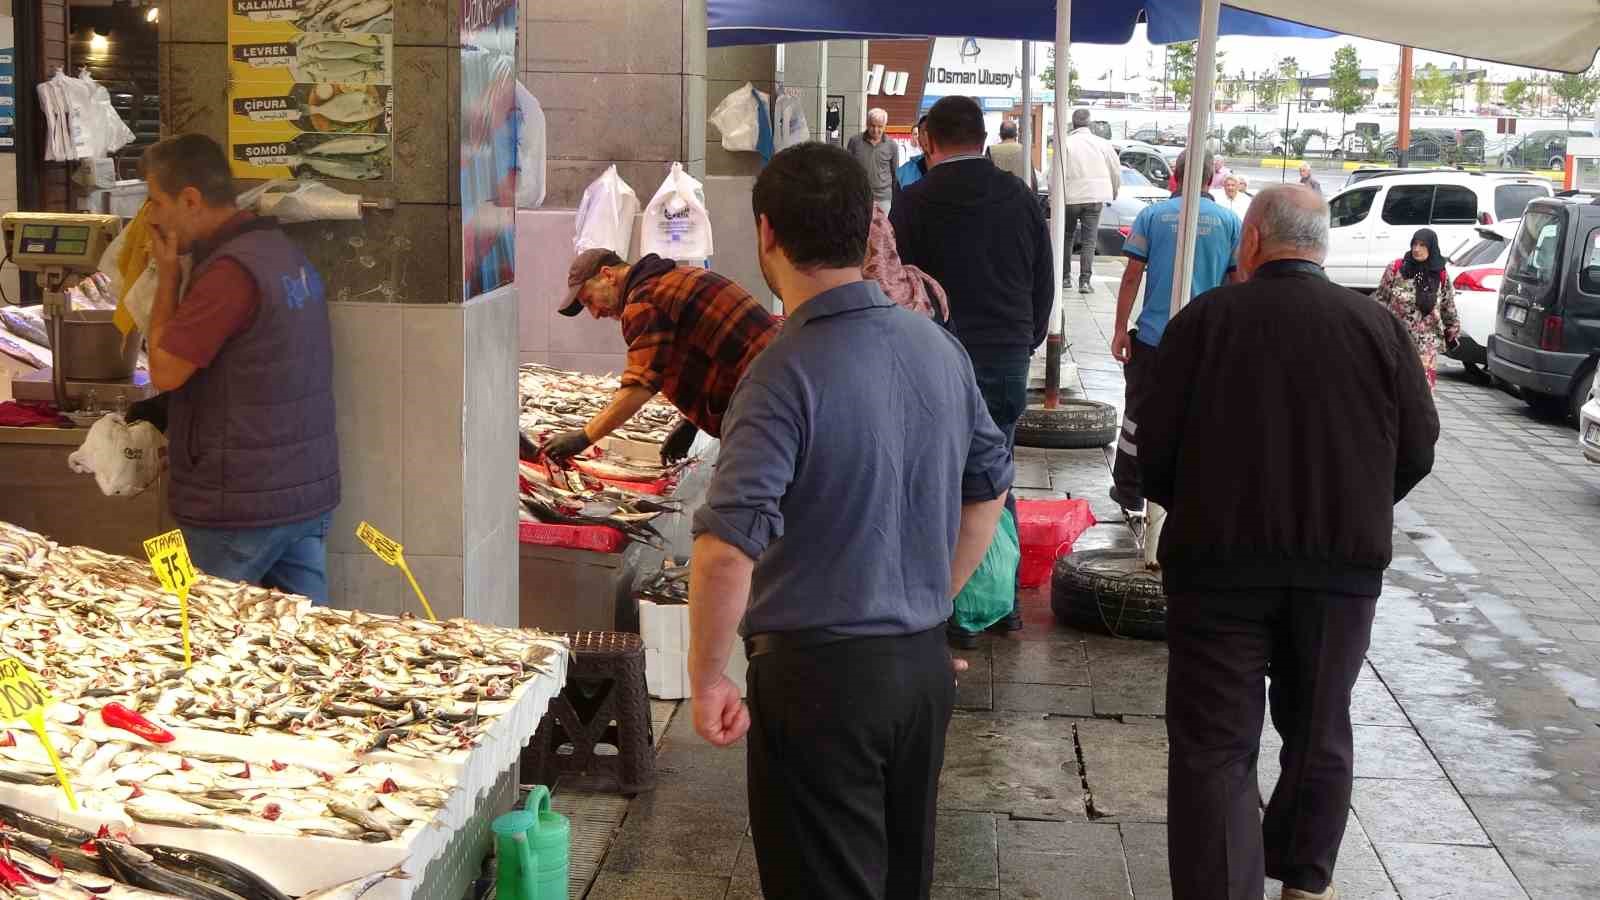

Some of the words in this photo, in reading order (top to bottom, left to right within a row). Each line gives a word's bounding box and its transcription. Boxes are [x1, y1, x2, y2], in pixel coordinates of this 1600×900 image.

[243, 45, 289, 57] LEVREK
[937, 67, 977, 85] Osman
[978, 69, 1014, 88] Ulusoy
[244, 99, 288, 113] ÇİPURA
